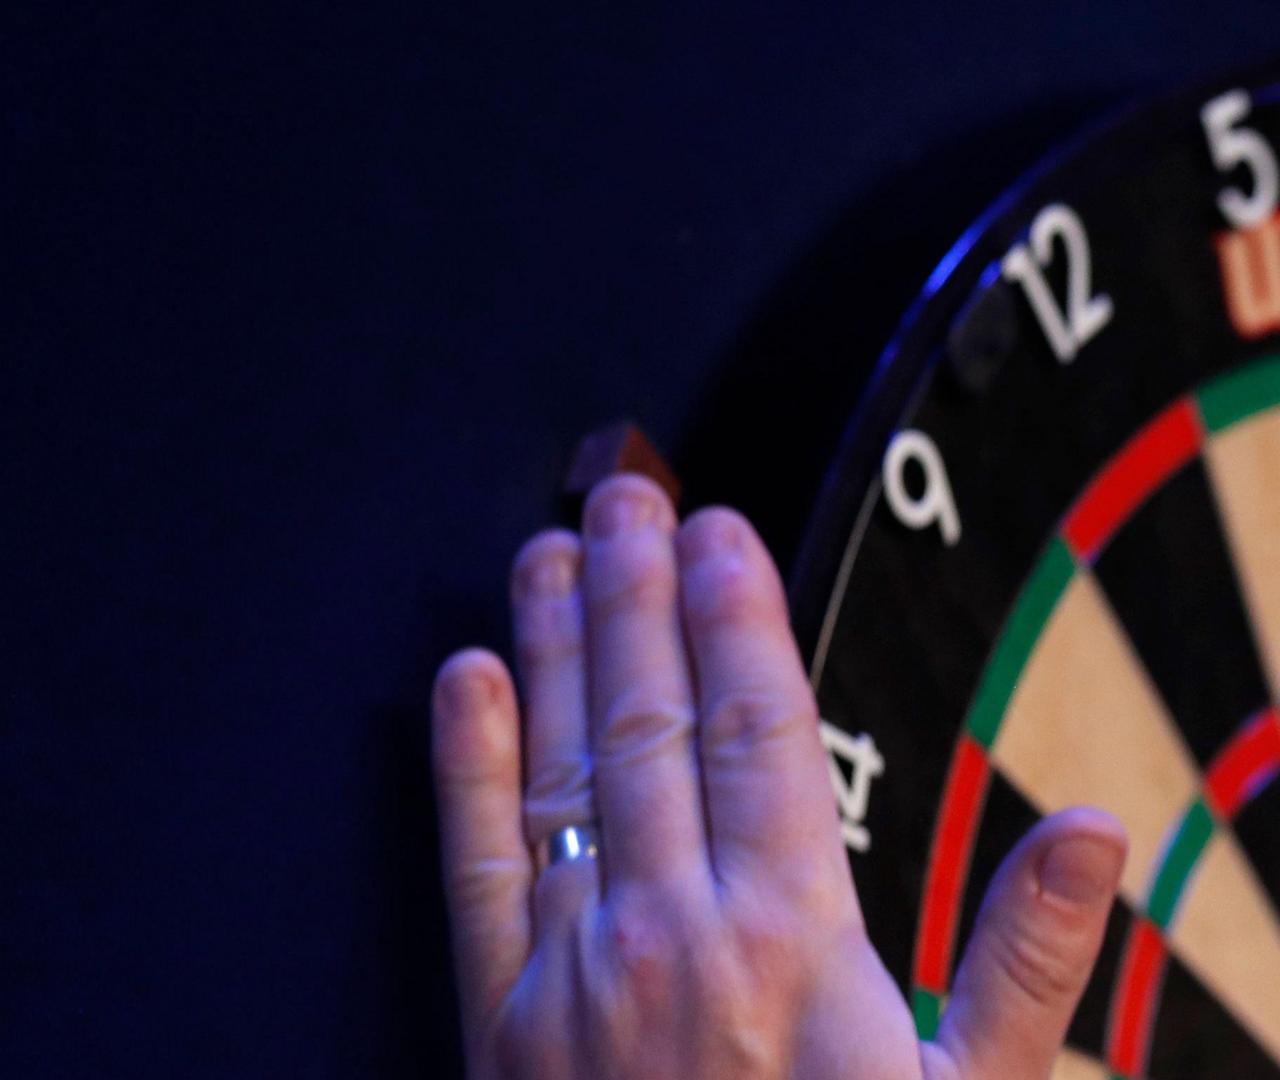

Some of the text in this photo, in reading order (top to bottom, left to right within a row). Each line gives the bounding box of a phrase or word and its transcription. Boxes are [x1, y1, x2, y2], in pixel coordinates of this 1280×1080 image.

[1202, 88, 1280, 229] 5
[1001, 203, 1113, 363] 12
[882, 428, 962, 546] 9
